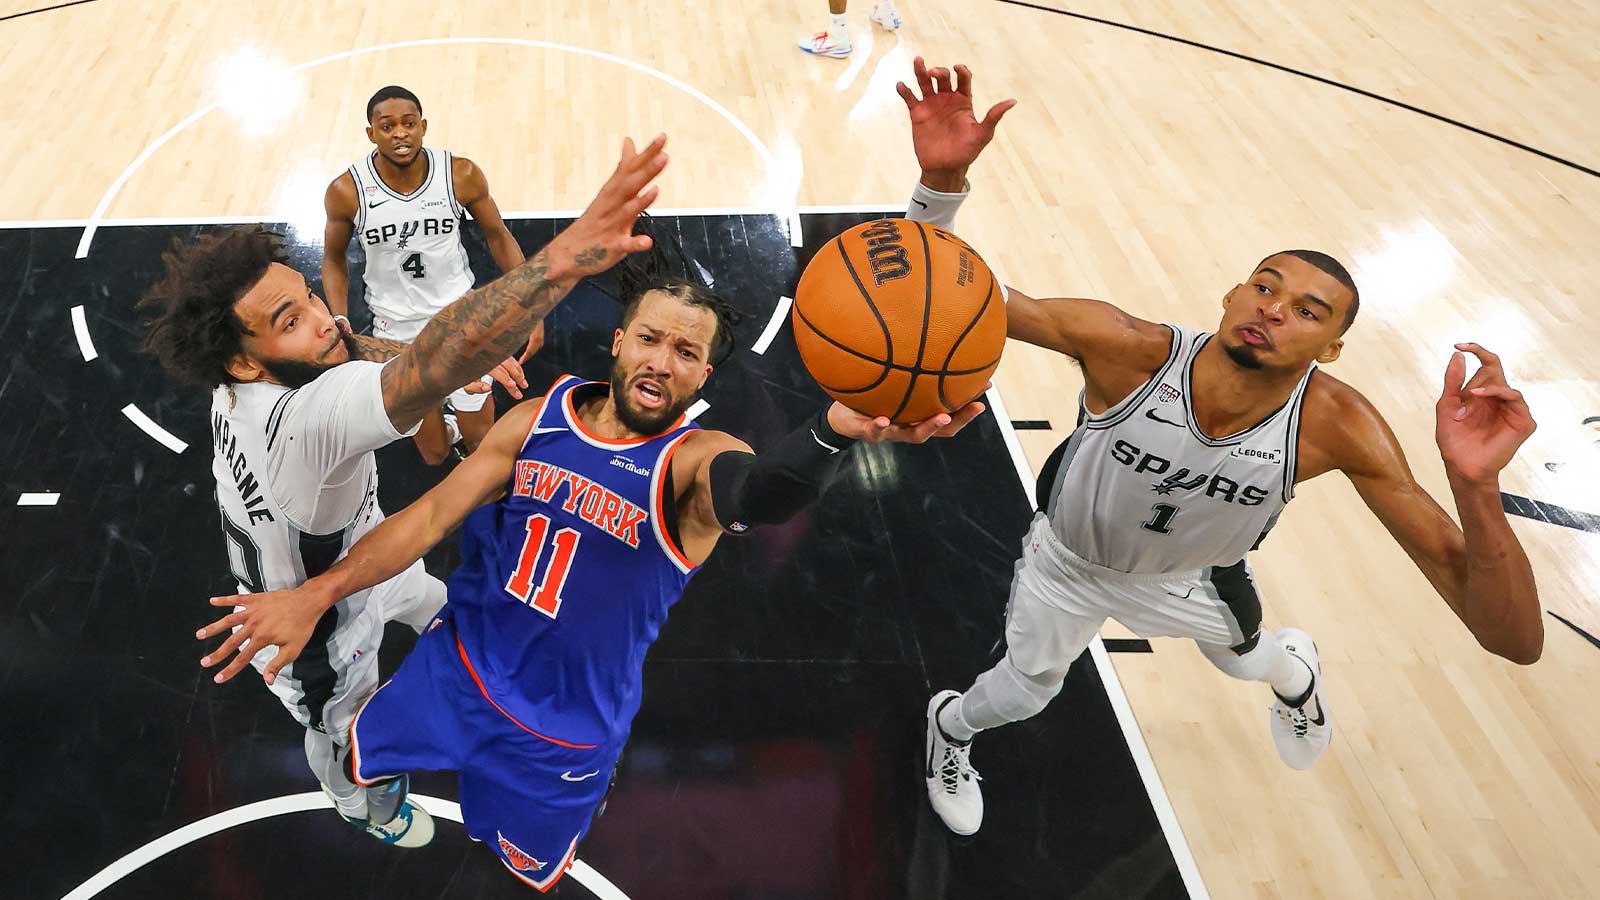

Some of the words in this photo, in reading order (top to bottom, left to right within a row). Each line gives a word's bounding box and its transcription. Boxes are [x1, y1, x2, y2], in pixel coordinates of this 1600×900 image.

[365, 218, 455, 249] SPURS
[401, 251, 426, 279] 4
[1237, 447, 1275, 460] LEDGER
[625, 462, 651, 477] dhabi
[1111, 439, 1269, 506] SPURS
[513, 459, 566, 503] NEW
[561, 474, 649, 550] YORK
[1141, 503, 1180, 535] 1
[504, 512, 582, 620] 11
